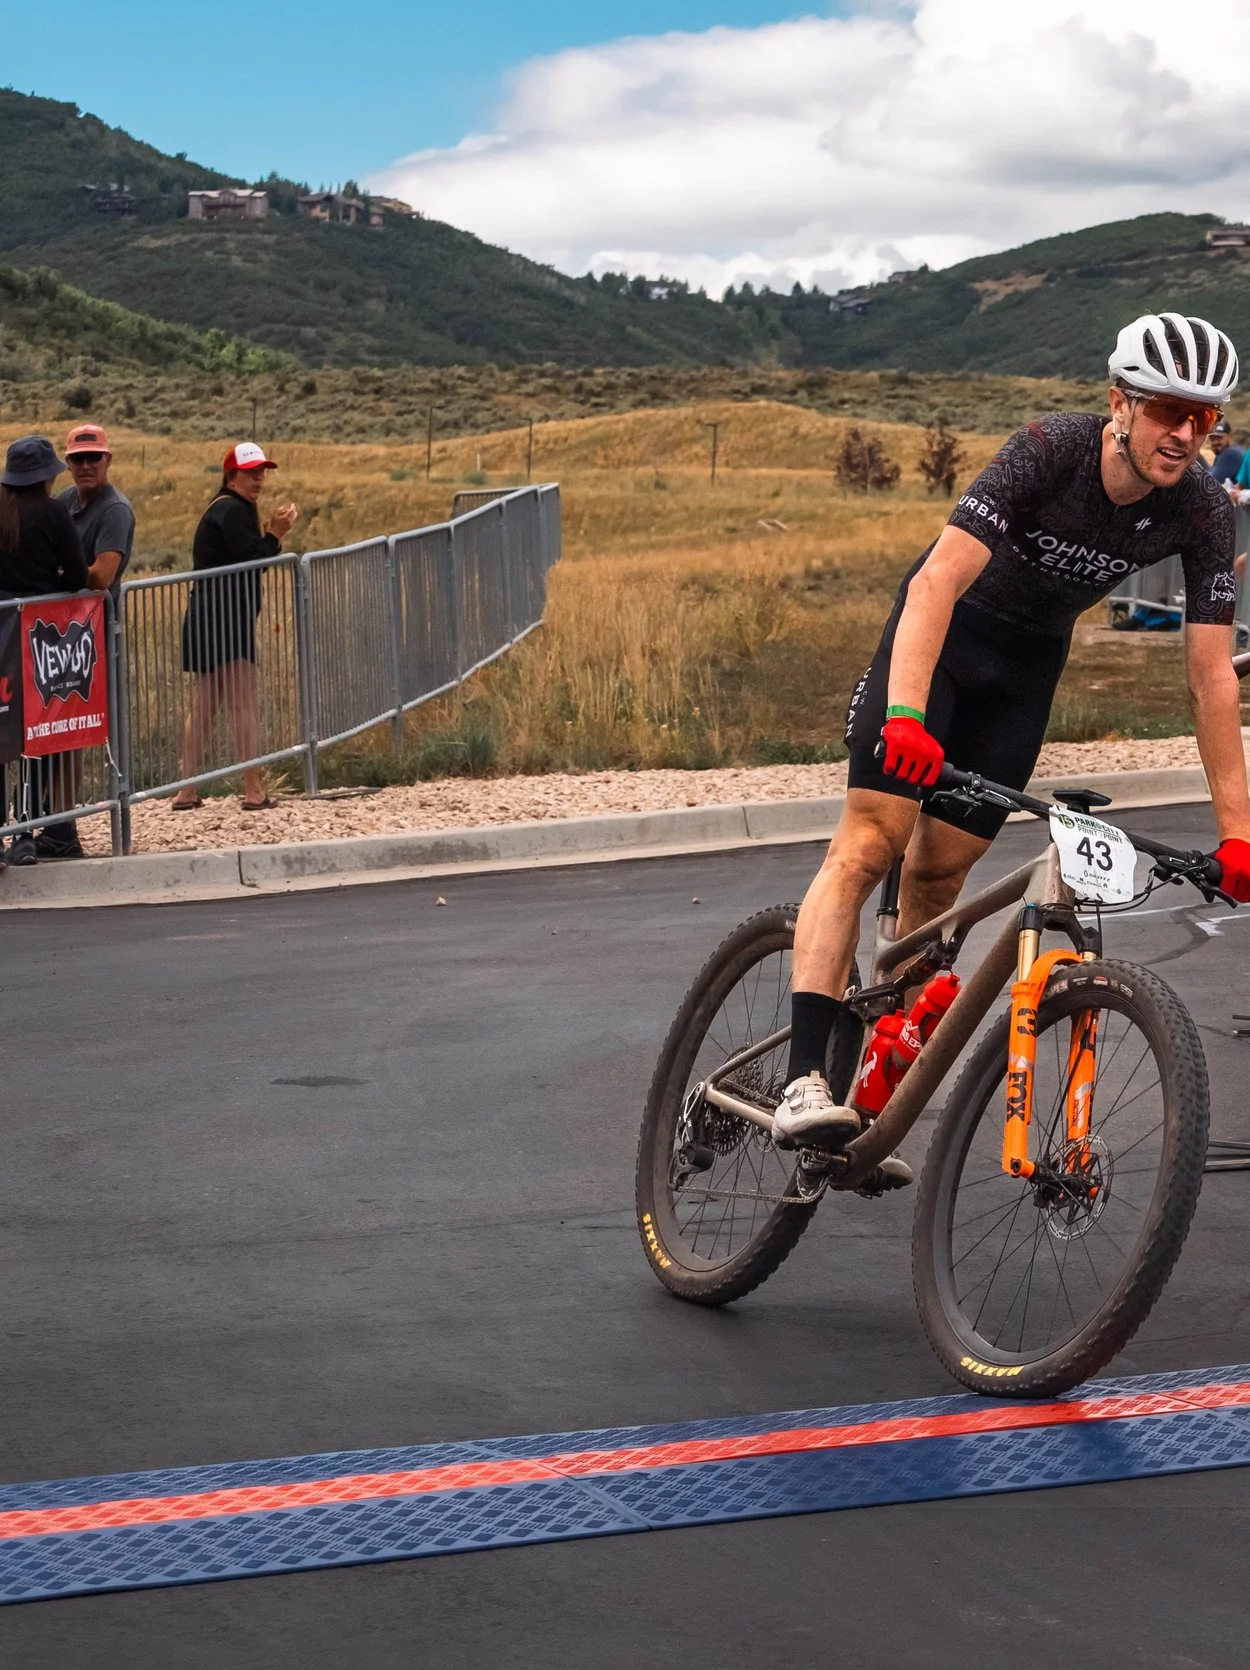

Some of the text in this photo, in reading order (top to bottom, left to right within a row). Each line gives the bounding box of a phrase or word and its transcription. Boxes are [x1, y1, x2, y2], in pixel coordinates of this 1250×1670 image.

[958, 495, 1009, 534] URBAN
[1076, 836, 1113, 871] 43
[1006, 1071, 1027, 1123] FOX
[643, 1213, 672, 1268] MAXXIS
[960, 1356, 1025, 1377] MAXXIS
